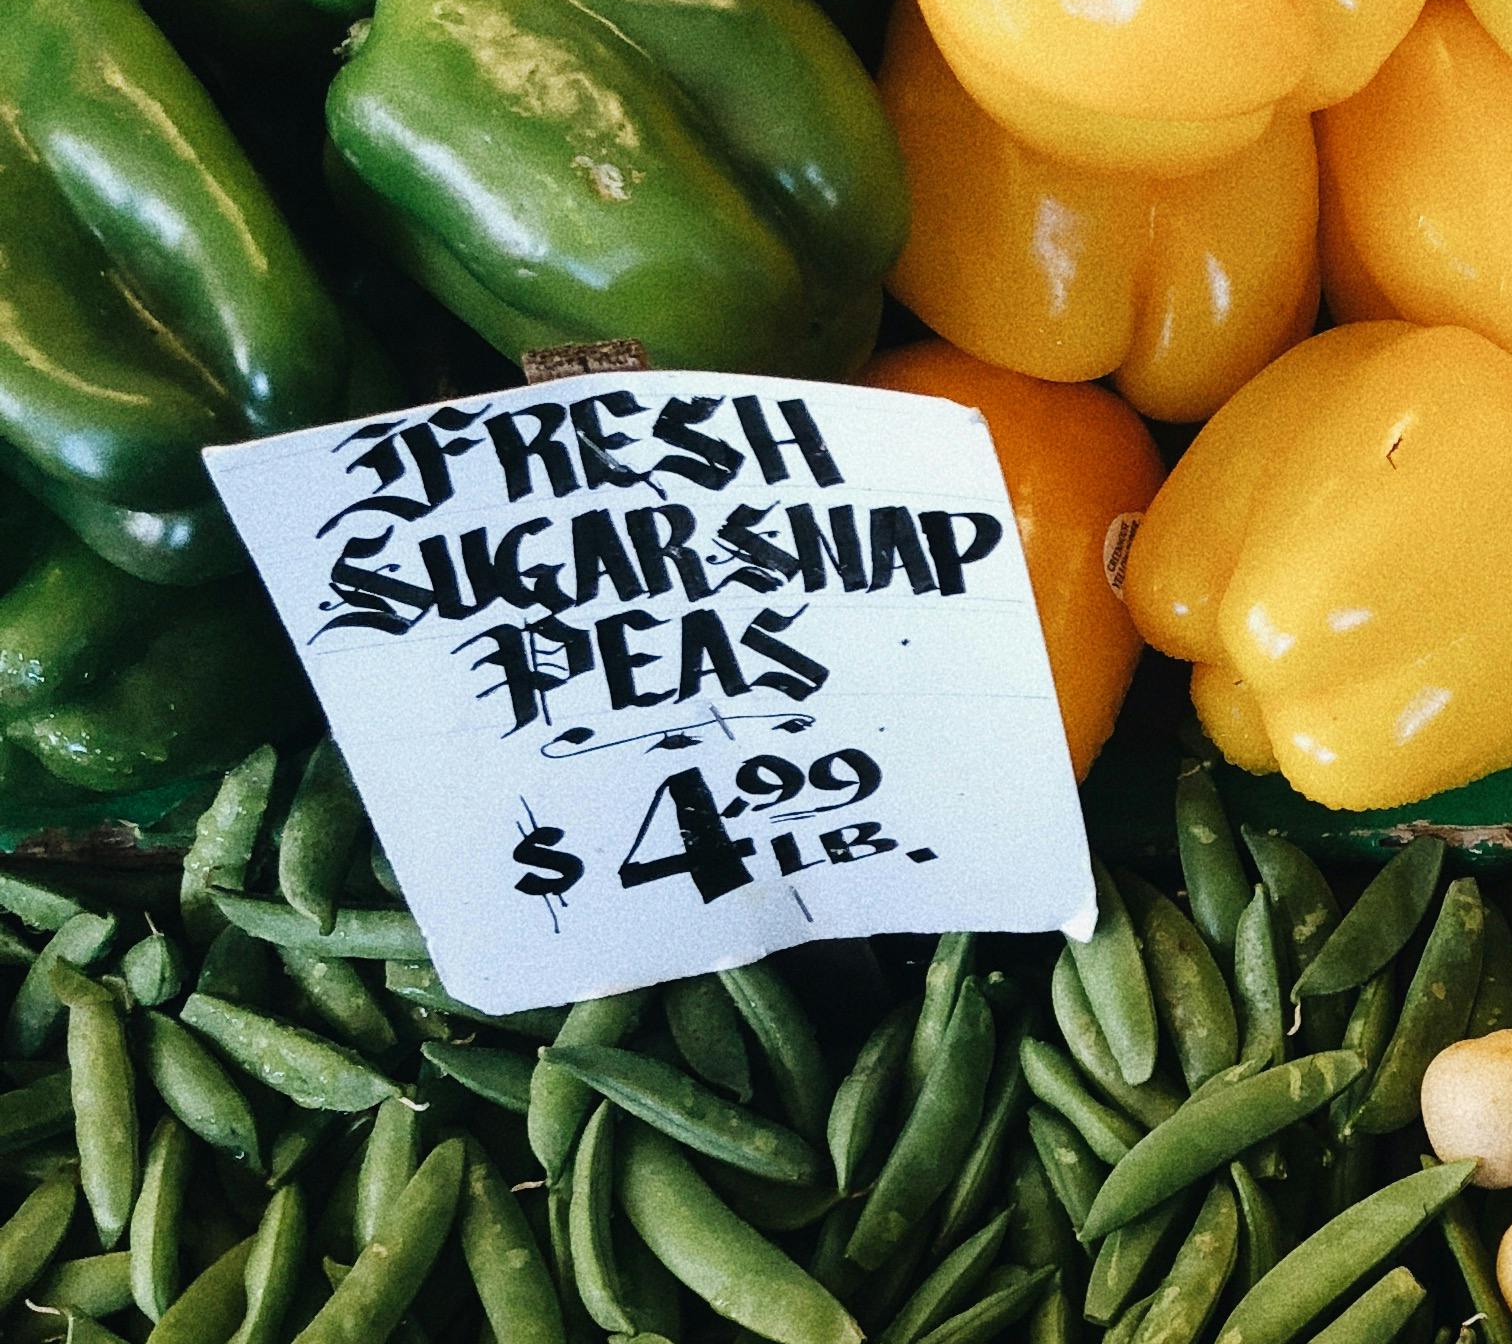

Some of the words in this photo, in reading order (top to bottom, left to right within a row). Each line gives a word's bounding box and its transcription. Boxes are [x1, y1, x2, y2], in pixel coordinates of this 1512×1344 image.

[316, 390, 846, 540] FRESH
[451, 603, 830, 740] PEAS
[771, 821, 938, 877] LB.
